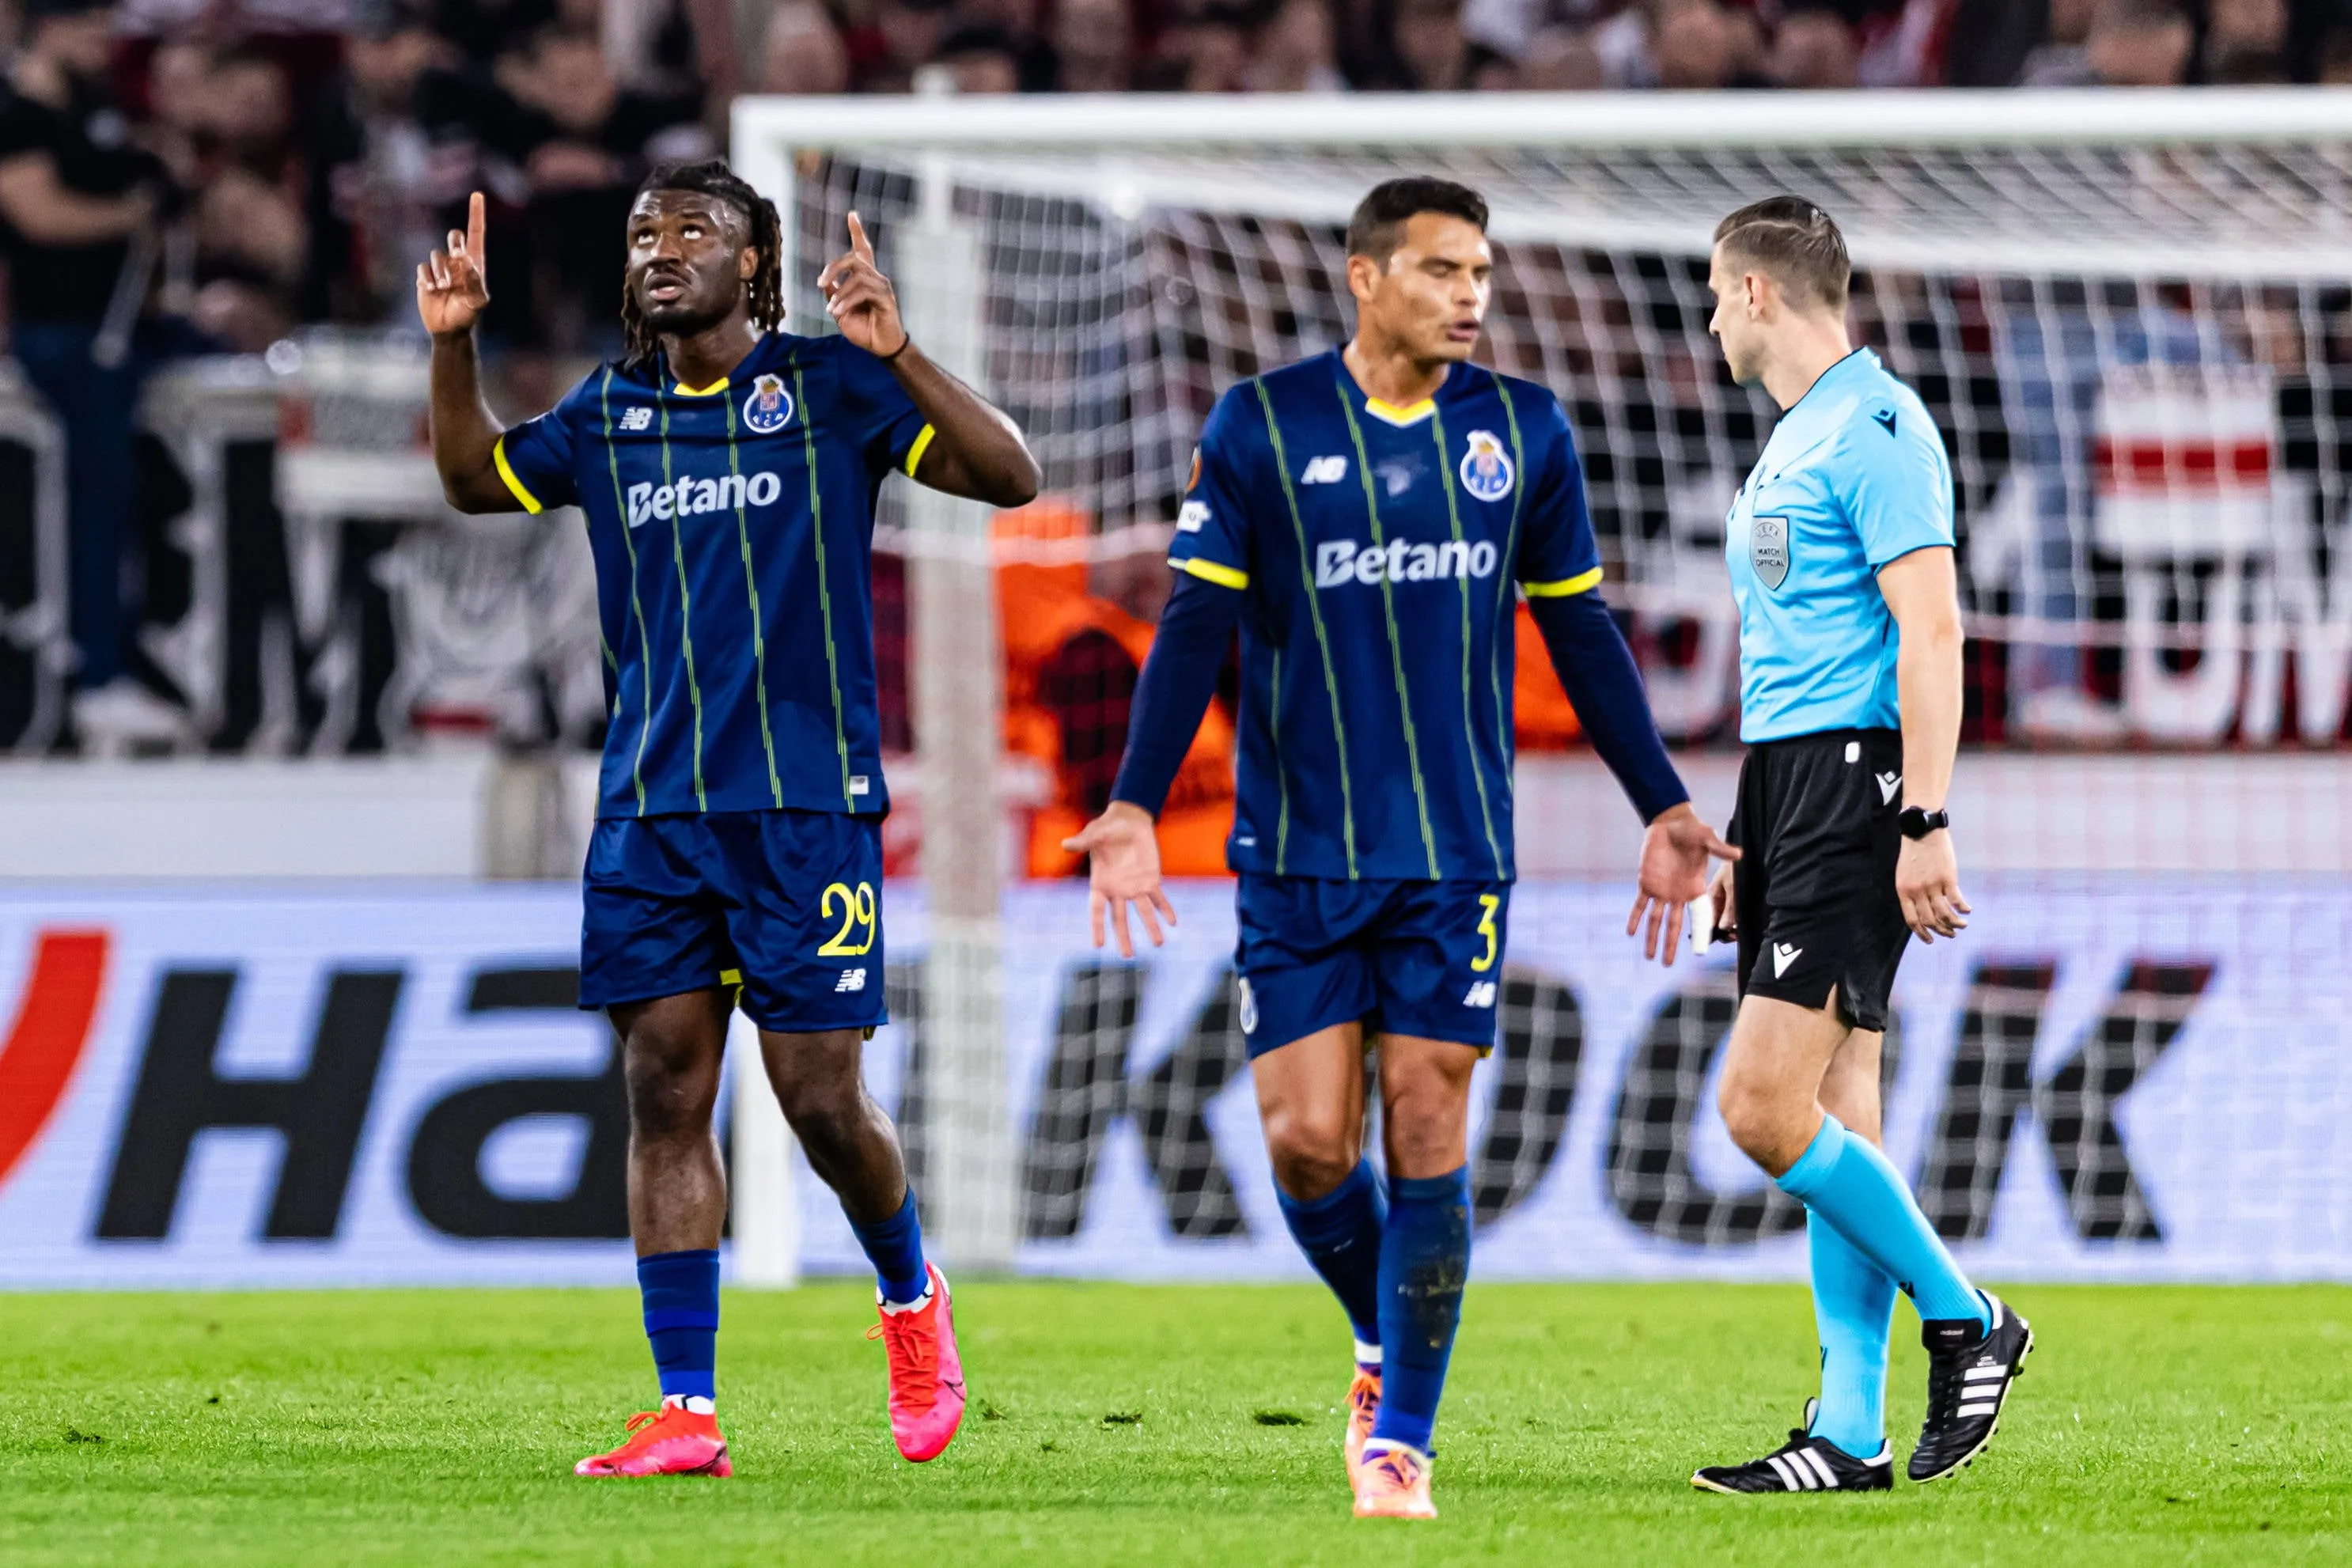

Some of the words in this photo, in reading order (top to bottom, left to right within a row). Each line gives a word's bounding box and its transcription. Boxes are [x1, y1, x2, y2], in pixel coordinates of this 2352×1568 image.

[627, 472, 782, 529] Betano
[1754, 525, 1779, 538] UEFA
[1758, 547, 1780, 556] MATCH
[1315, 537, 1498, 589] Betano
[1755, 559, 1785, 567] OFFICIAL
[816, 881, 875, 956] 29
[1470, 893, 1500, 972] 3
